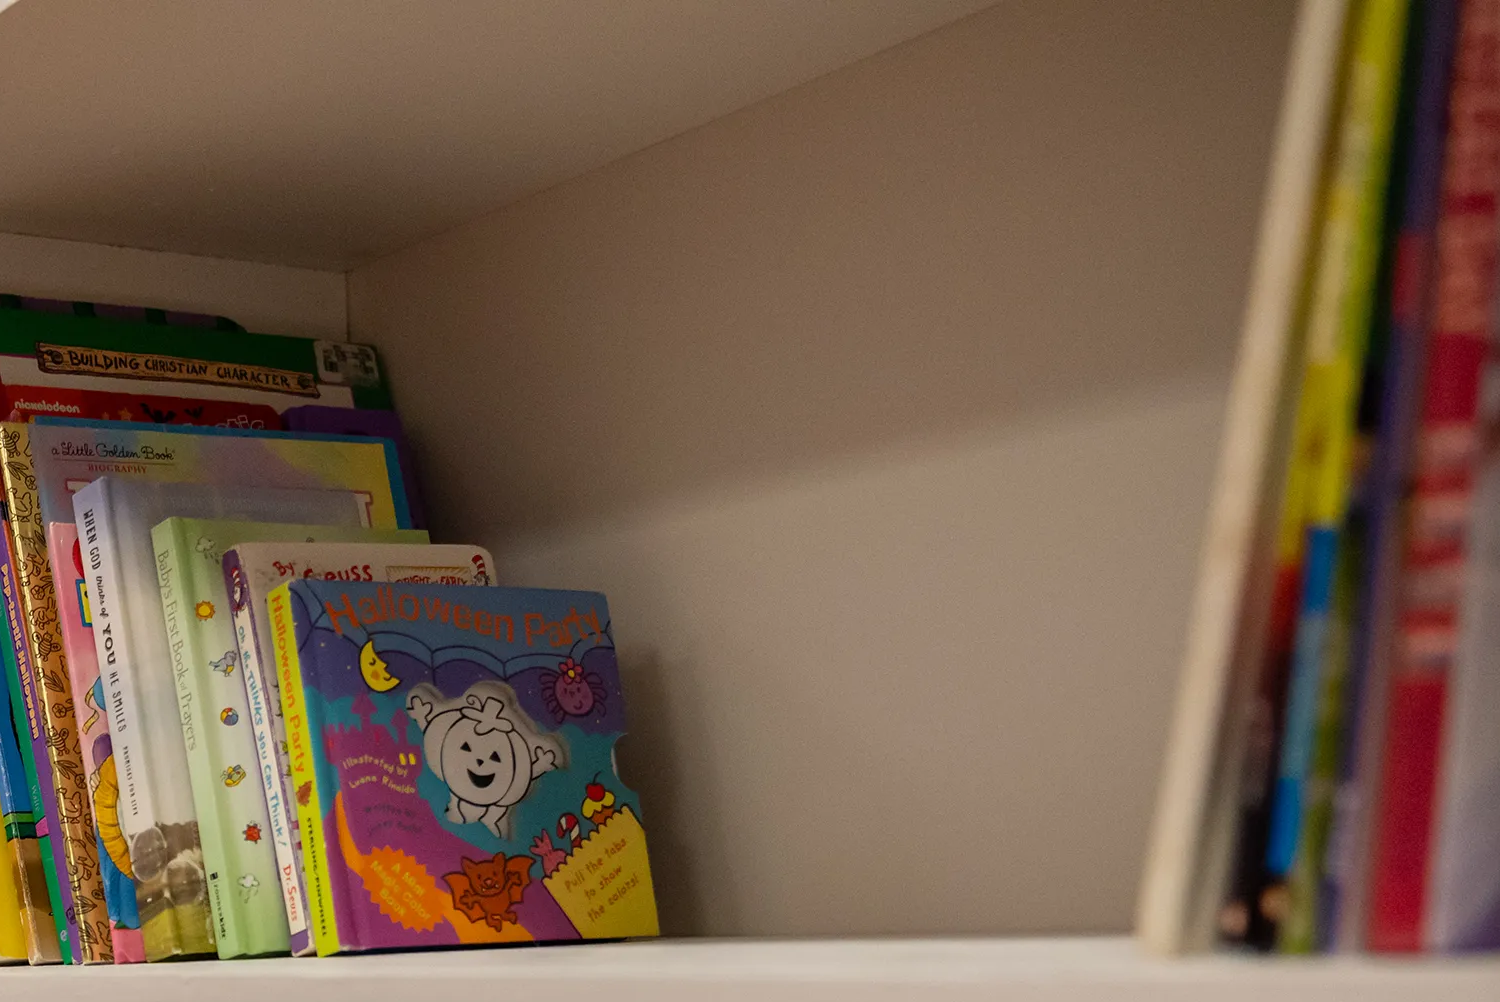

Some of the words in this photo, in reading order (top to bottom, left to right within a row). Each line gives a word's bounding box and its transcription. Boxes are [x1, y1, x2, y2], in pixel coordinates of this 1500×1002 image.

[68, 350, 140, 371] BUILDING
[145, 357, 209, 375] CHRISTIAN
[217, 366, 291, 389] CHARACTER
[14, 399, 81, 414] nickelodeon
[60, 441, 95, 457] Little
[96, 442, 141, 460] Golden
[141, 446, 175, 461] Book
[88, 464, 148, 475] BIOGRAPHY
[83, 508, 97, 545] WHEN
[89, 547, 101, 571] GOD
[157, 549, 173, 600] Baby's
[273, 560, 296, 577] By
[100, 607, 109, 619] of
[166, 601, 179, 638] First
[325, 585, 515, 645] Halloween
[524, 604, 604, 648] Party
[1, 563, 21, 650] Pup-tastic
[17, 648, 40, 741] Halloween
[102, 623, 116, 666] YOU
[172, 641, 189, 680] Book
[109, 672, 119, 687] HE
[271, 595, 296, 709] Halloween
[290, 714, 305, 773] Party
[112, 690, 127, 732] SMILES
[181, 693, 198, 752] Prayers
[257, 731, 267, 760] you
[263, 764, 273, 790] Can
[342, 754, 395, 774] Illustrated
[390, 862, 401, 875] A
[564, 871, 586, 892] Pull
[585, 858, 603, 874] the
[604, 838, 627, 858] tabs
[585, 888, 596, 900] to
[599, 866, 622, 890] show
[282, 864, 292, 883] Dr.
[287, 885, 297, 922] Seuss
[380, 887, 407, 917] Book
[402, 891, 432, 920] Color
[587, 905, 605, 922] the
